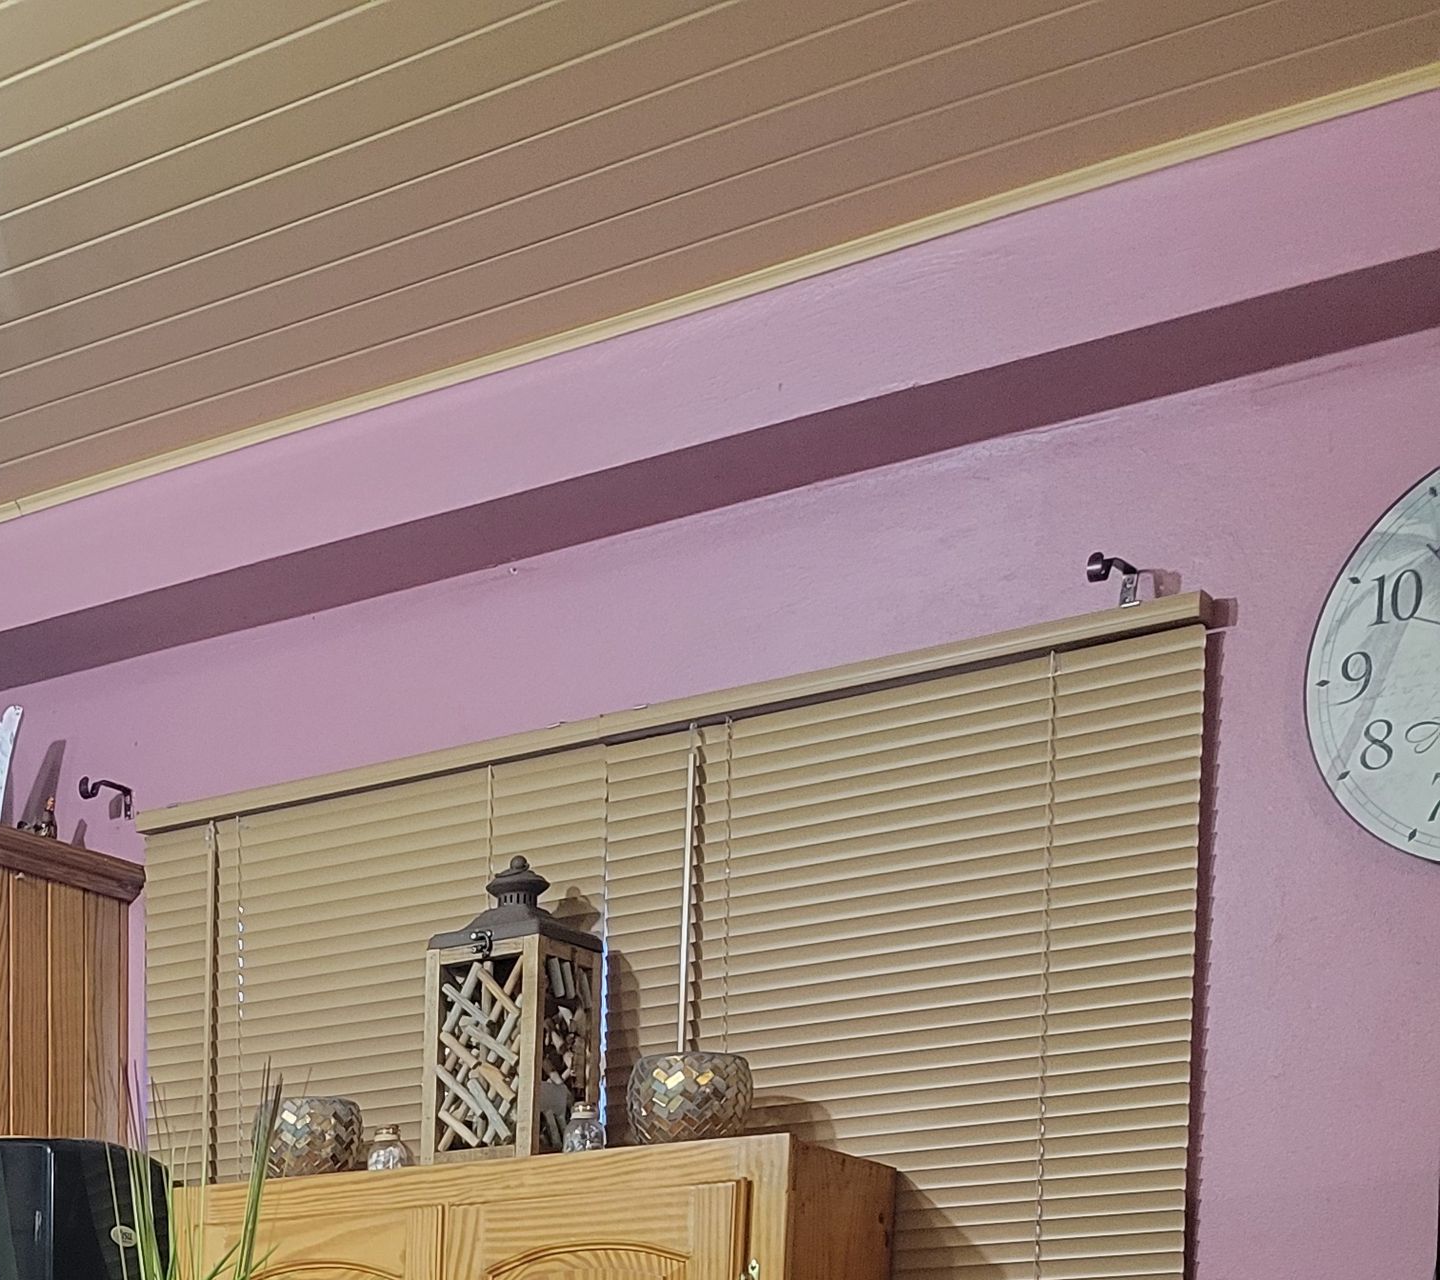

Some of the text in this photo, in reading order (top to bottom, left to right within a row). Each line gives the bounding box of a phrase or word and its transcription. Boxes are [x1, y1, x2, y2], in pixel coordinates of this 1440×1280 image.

[1368, 569, 1423, 628] 10
[1334, 651, 1372, 706] 9
[1360, 719, 1394, 770] 8
